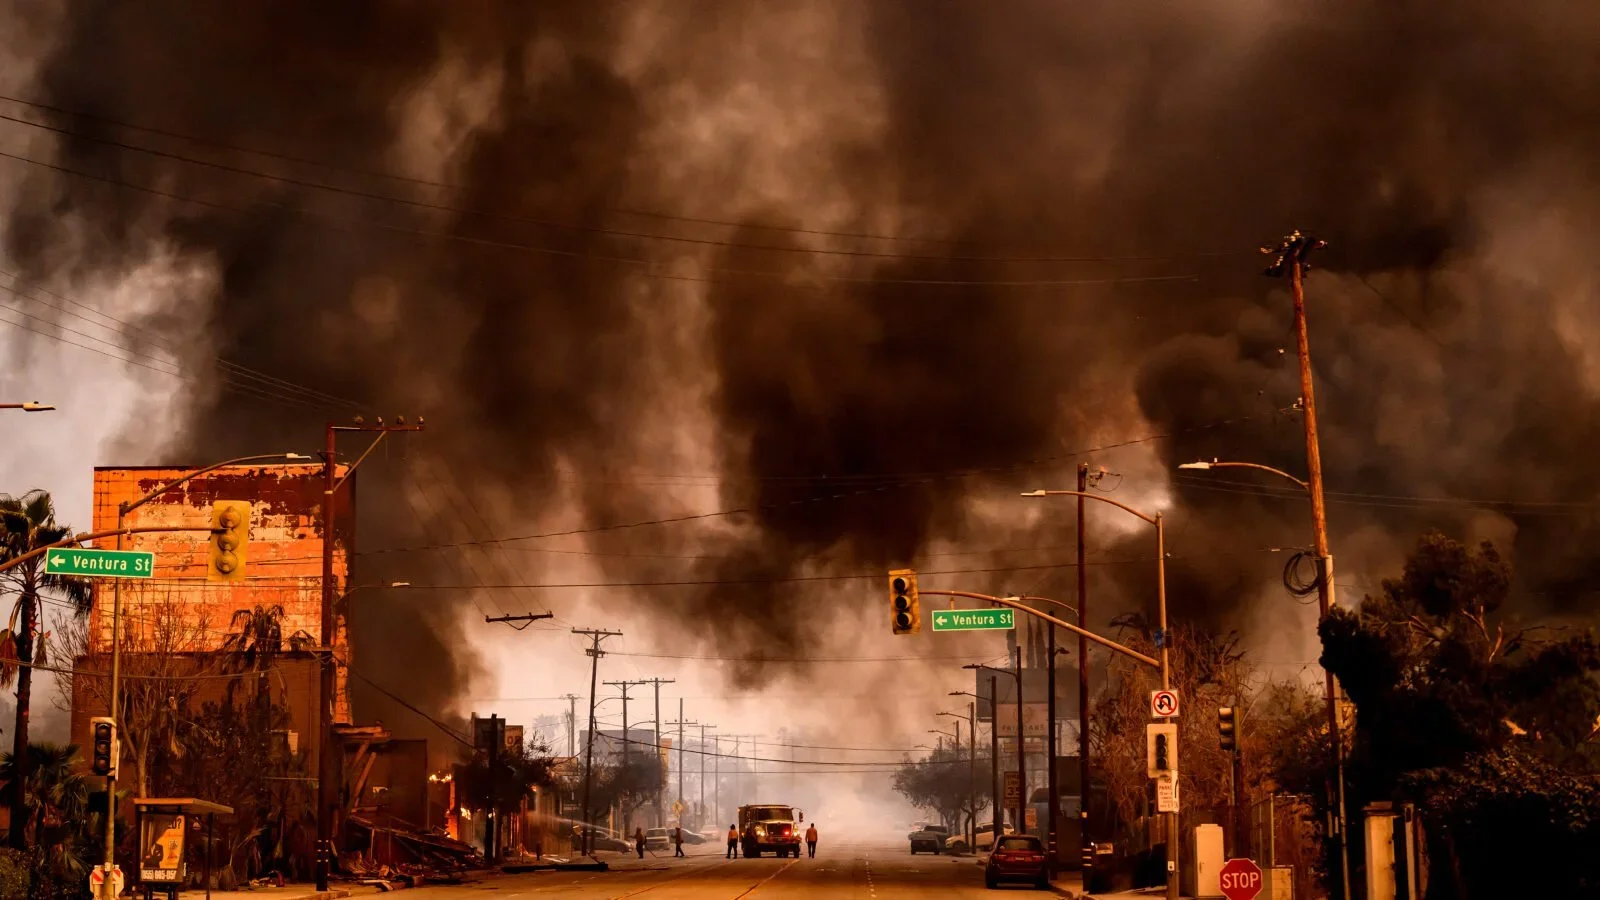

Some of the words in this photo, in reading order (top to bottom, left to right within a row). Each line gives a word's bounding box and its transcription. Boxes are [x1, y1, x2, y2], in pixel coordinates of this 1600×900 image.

[73, 555, 127, 571] Ventura
[134, 558, 150, 572] St
[953, 614, 995, 626] Ventura
[1000, 613, 1012, 624] St
[1222, 871, 1260, 889] STOP
